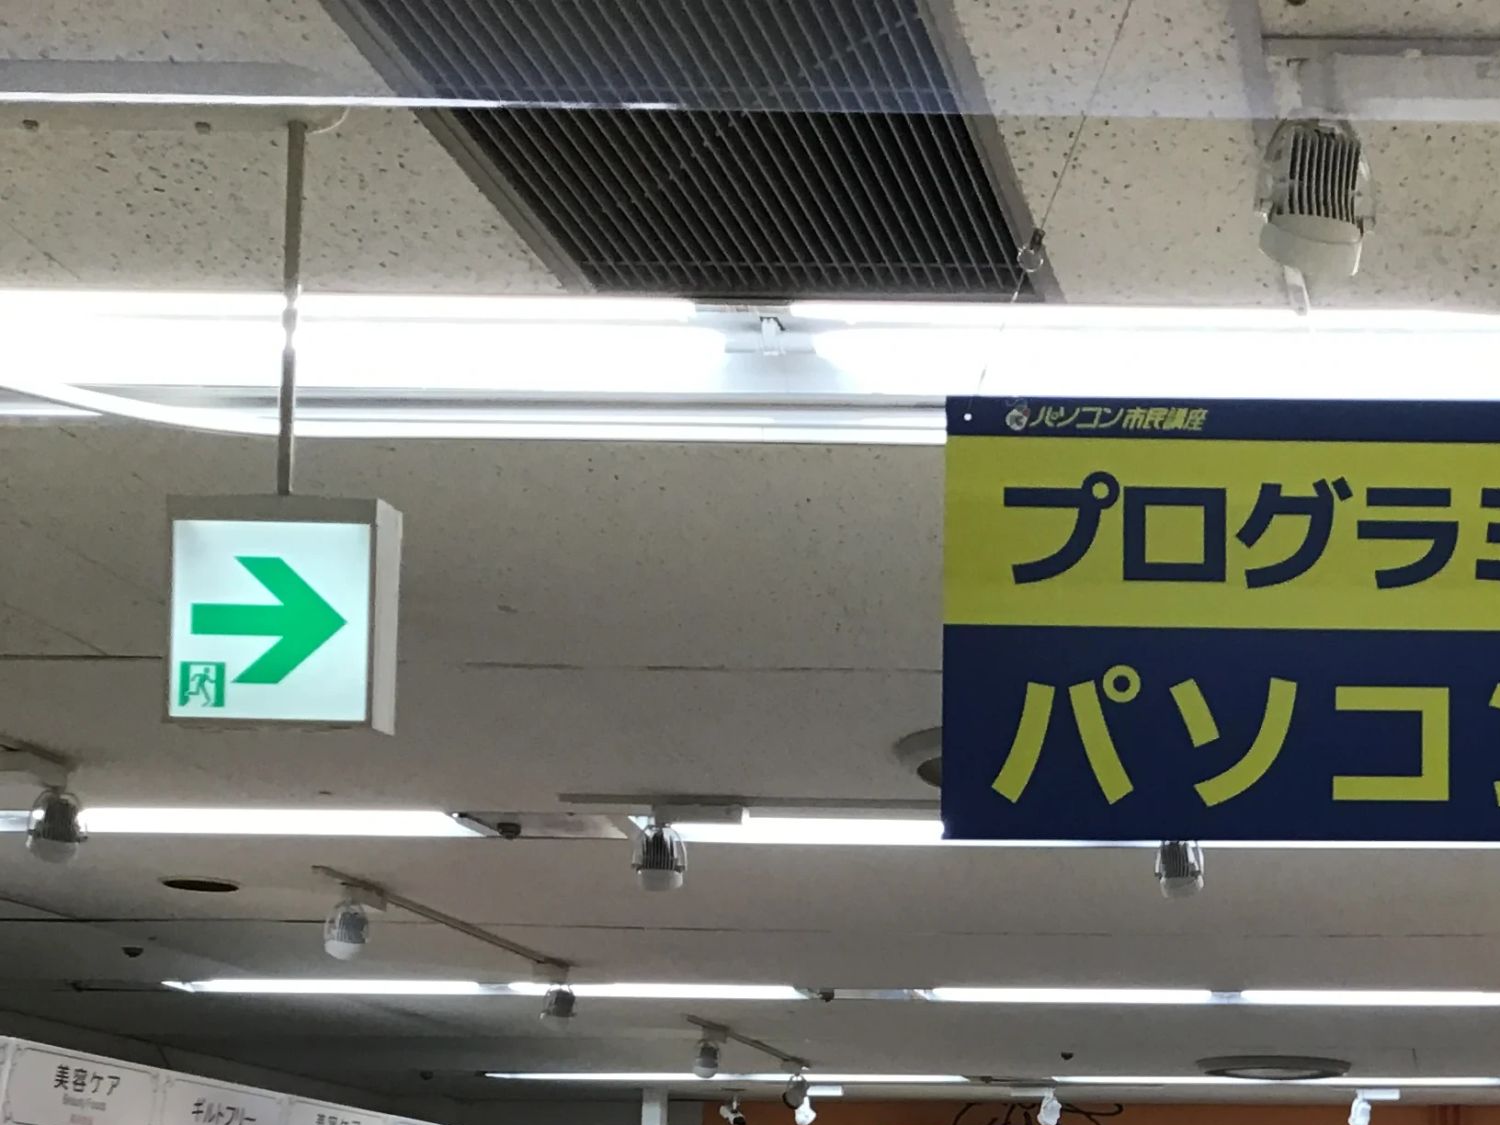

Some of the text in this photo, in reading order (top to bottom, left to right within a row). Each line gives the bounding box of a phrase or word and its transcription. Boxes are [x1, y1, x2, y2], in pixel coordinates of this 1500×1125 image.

[1029, 406, 1209, 432] パソコン市民講座
[53, 1064, 121, 1096] 美容ケア
